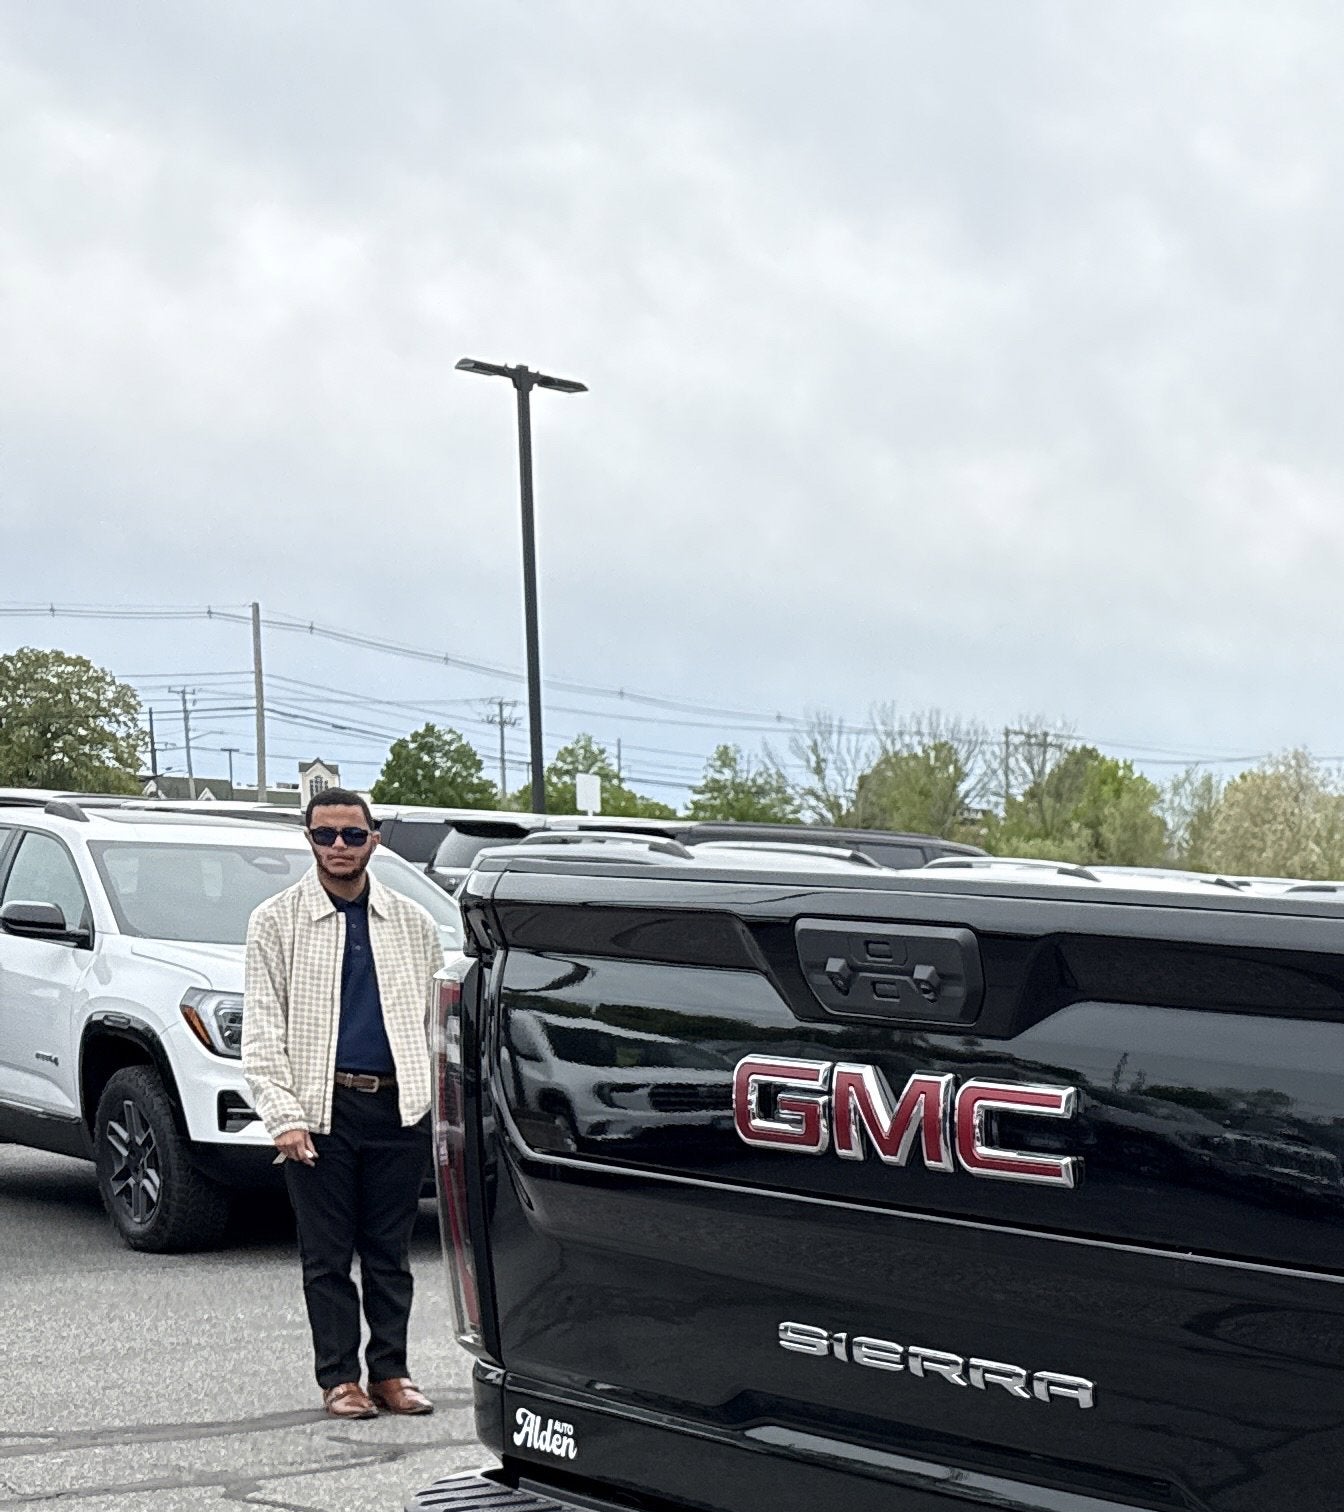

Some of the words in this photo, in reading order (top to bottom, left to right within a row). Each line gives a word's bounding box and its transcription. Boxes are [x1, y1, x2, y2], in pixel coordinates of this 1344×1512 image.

[733, 1053, 1079, 1190] GMC
[778, 1321, 1097, 1409] SIERRA
[513, 1407, 578, 1460] Alden
[553, 1420, 574, 1436] AUTO
